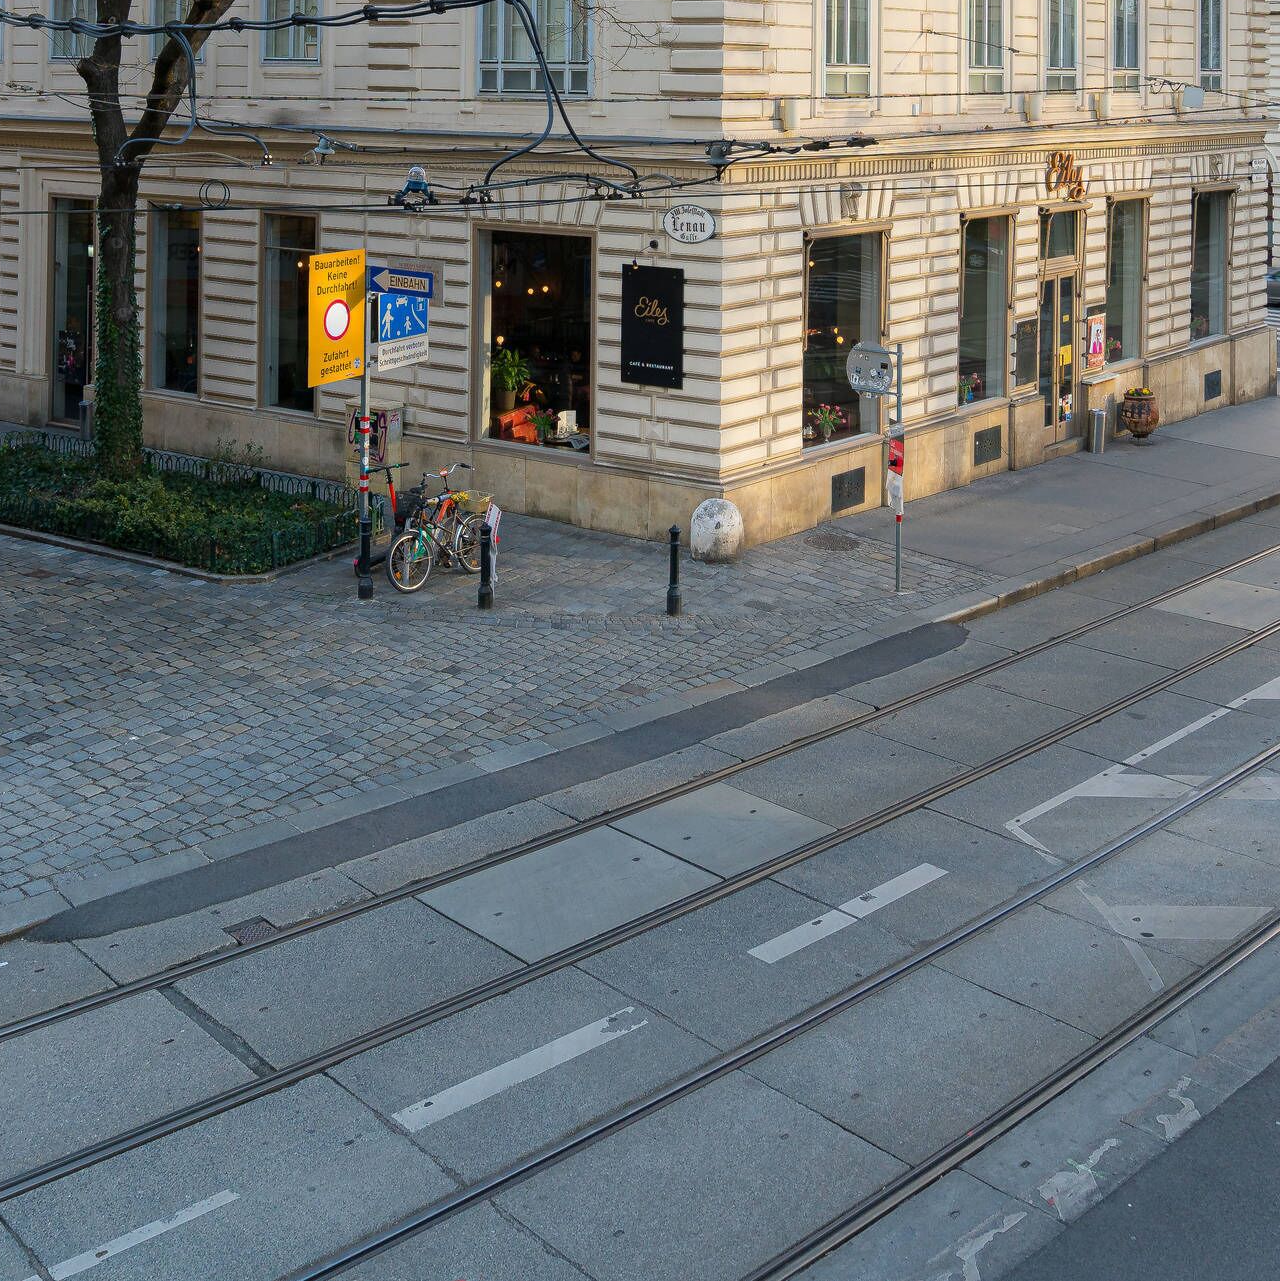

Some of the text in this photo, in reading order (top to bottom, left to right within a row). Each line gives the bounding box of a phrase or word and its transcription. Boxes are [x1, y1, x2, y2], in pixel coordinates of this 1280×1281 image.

[671, 216, 706, 233] Lenau
[314, 255, 360, 271] Bauarbeiten!
[327, 271, 348, 282] Keine
[389, 275, 426, 291] EINBAHN
[316, 281, 358, 296] Durchfahrt!
[634, 296, 670, 326] Eiles
[323, 349, 349, 363] Zufahrt
[320, 361, 352, 378] gestattet
